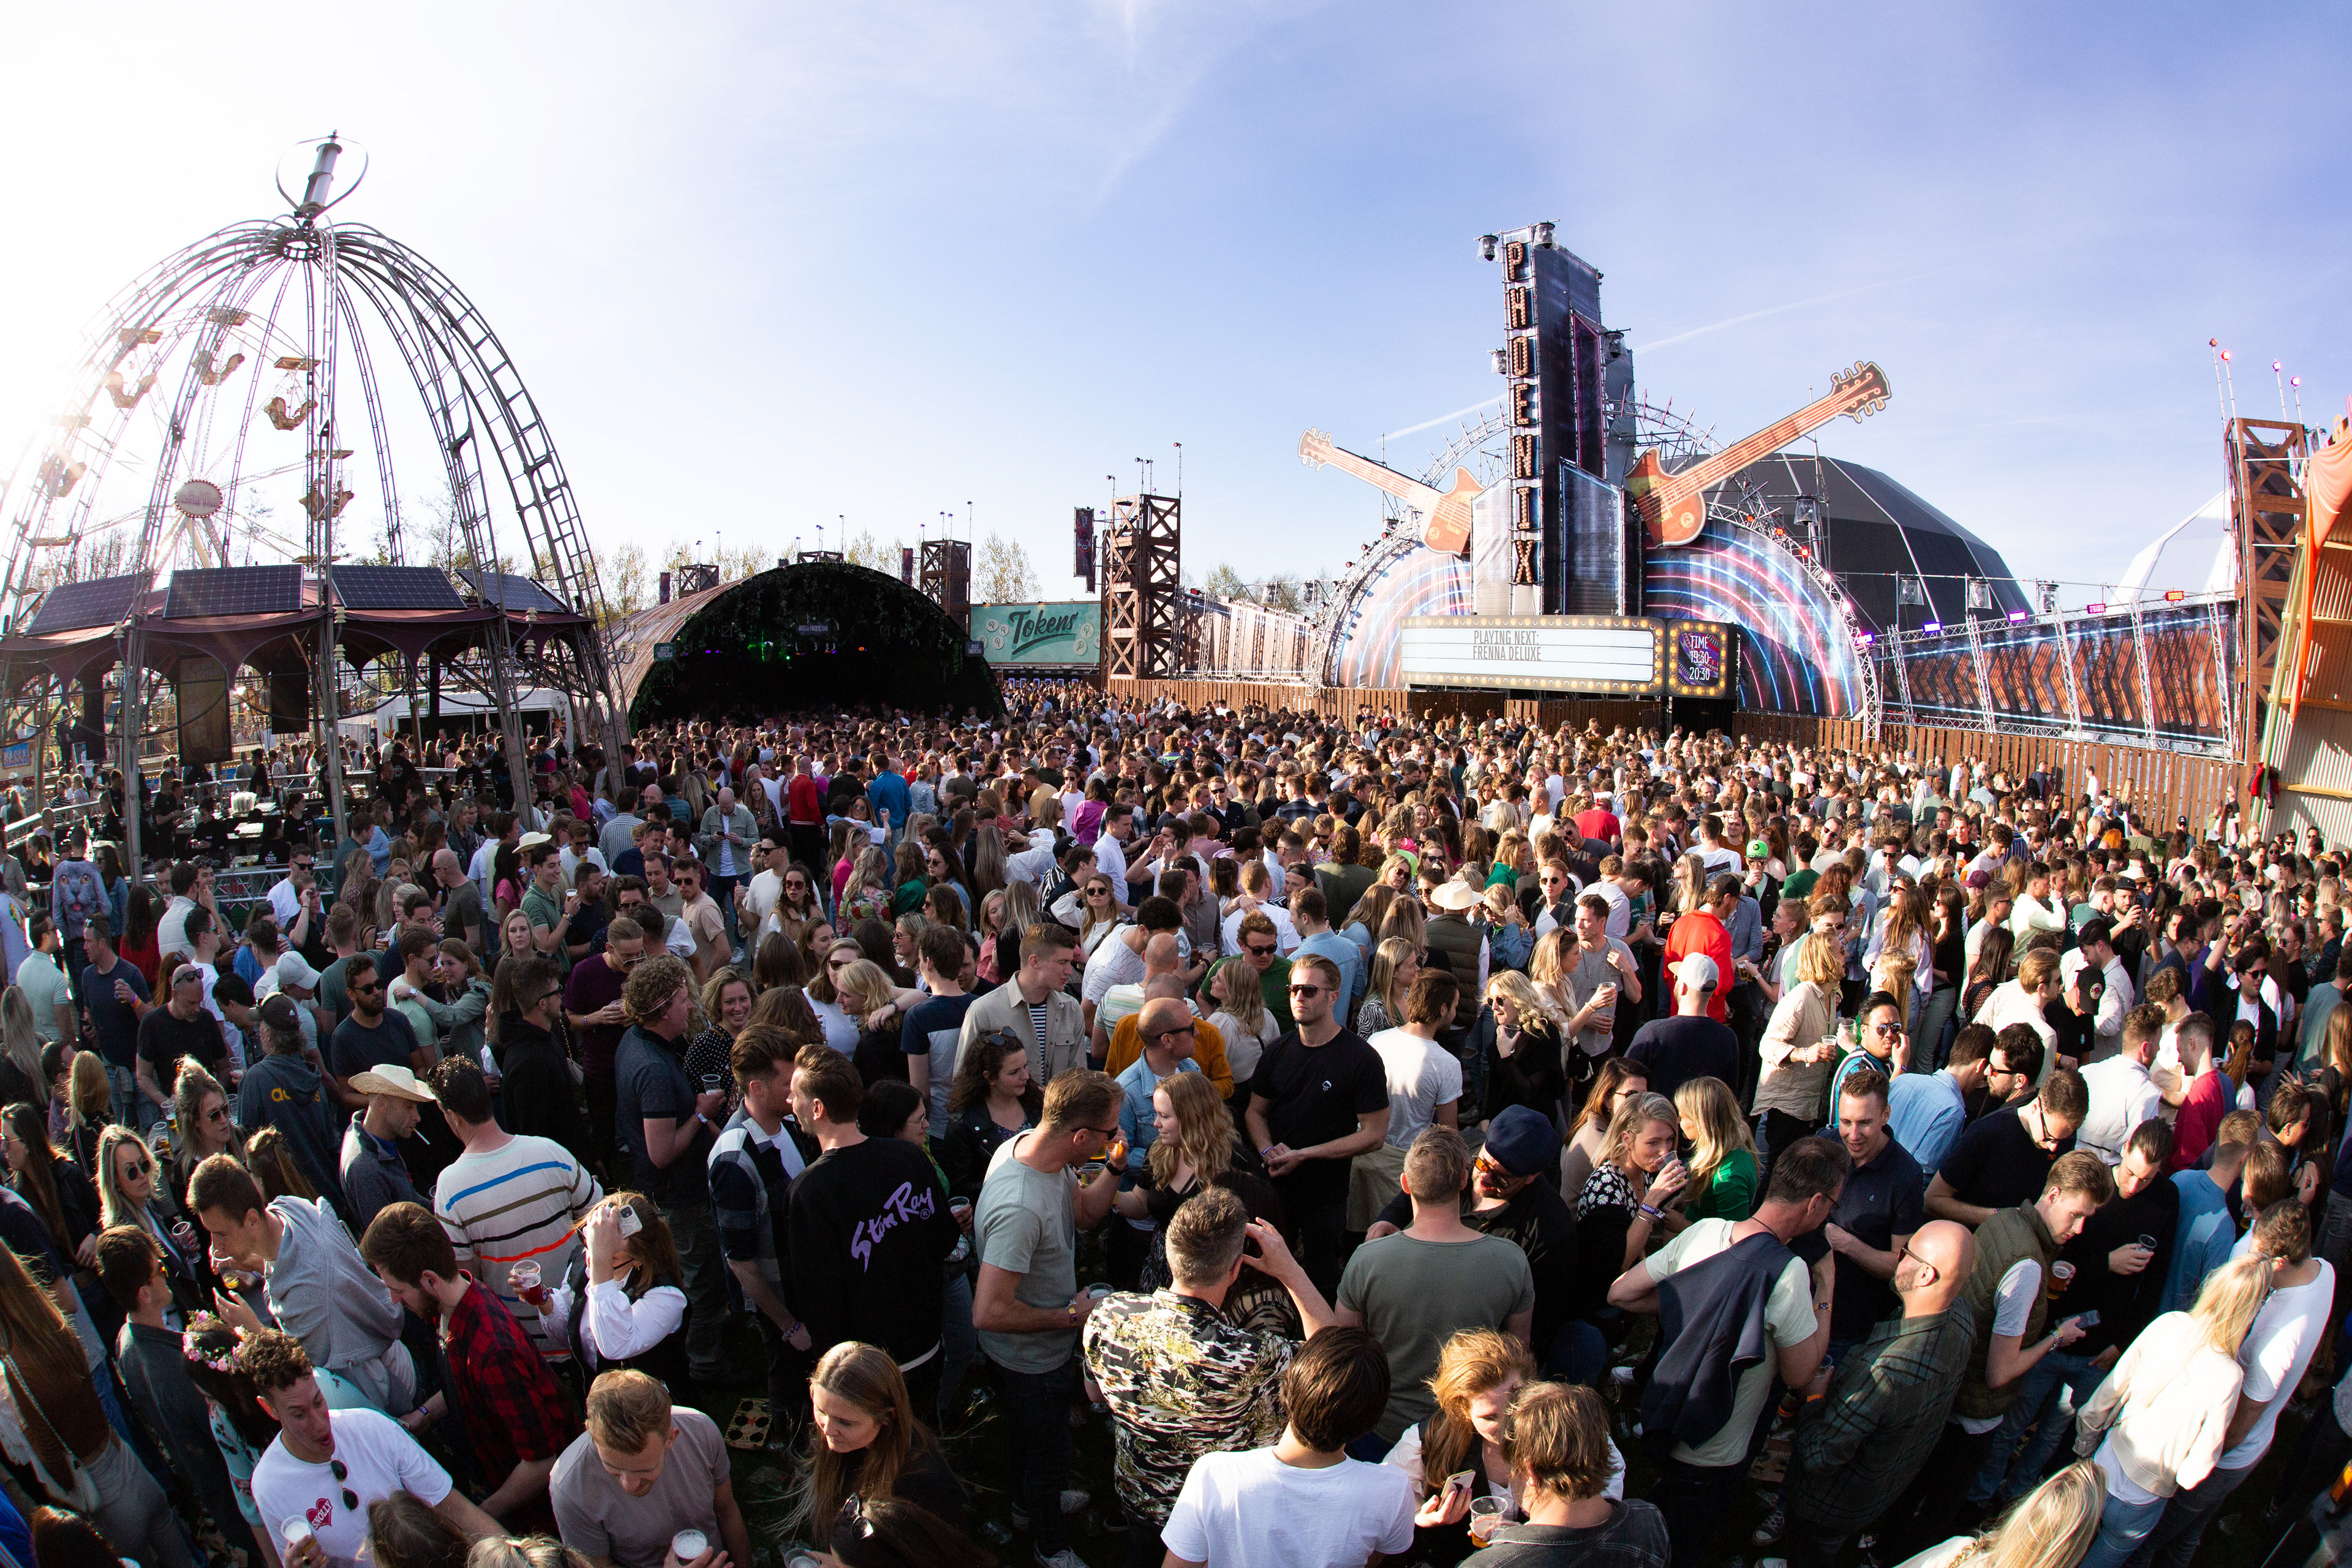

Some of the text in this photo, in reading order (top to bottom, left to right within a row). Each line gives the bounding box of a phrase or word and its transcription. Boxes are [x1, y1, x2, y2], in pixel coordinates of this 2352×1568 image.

[1507, 241, 1534, 584] PHOENIX
[1009, 609, 1079, 644] Tokens
[1474, 630, 1539, 645] PLAYING NEXT:
[1690, 635, 1708, 649] TIME
[1473, 646, 1542, 661] FRENNA DELUXE
[1690, 650, 1712, 664] 19:30-
[1689, 666, 1710, 680] 20:30
[3, 749, 28, 766] KASSA
[851, 1182, 935, 1273] Stan Ray
[311, 1500, 332, 1529] SNOLLY
